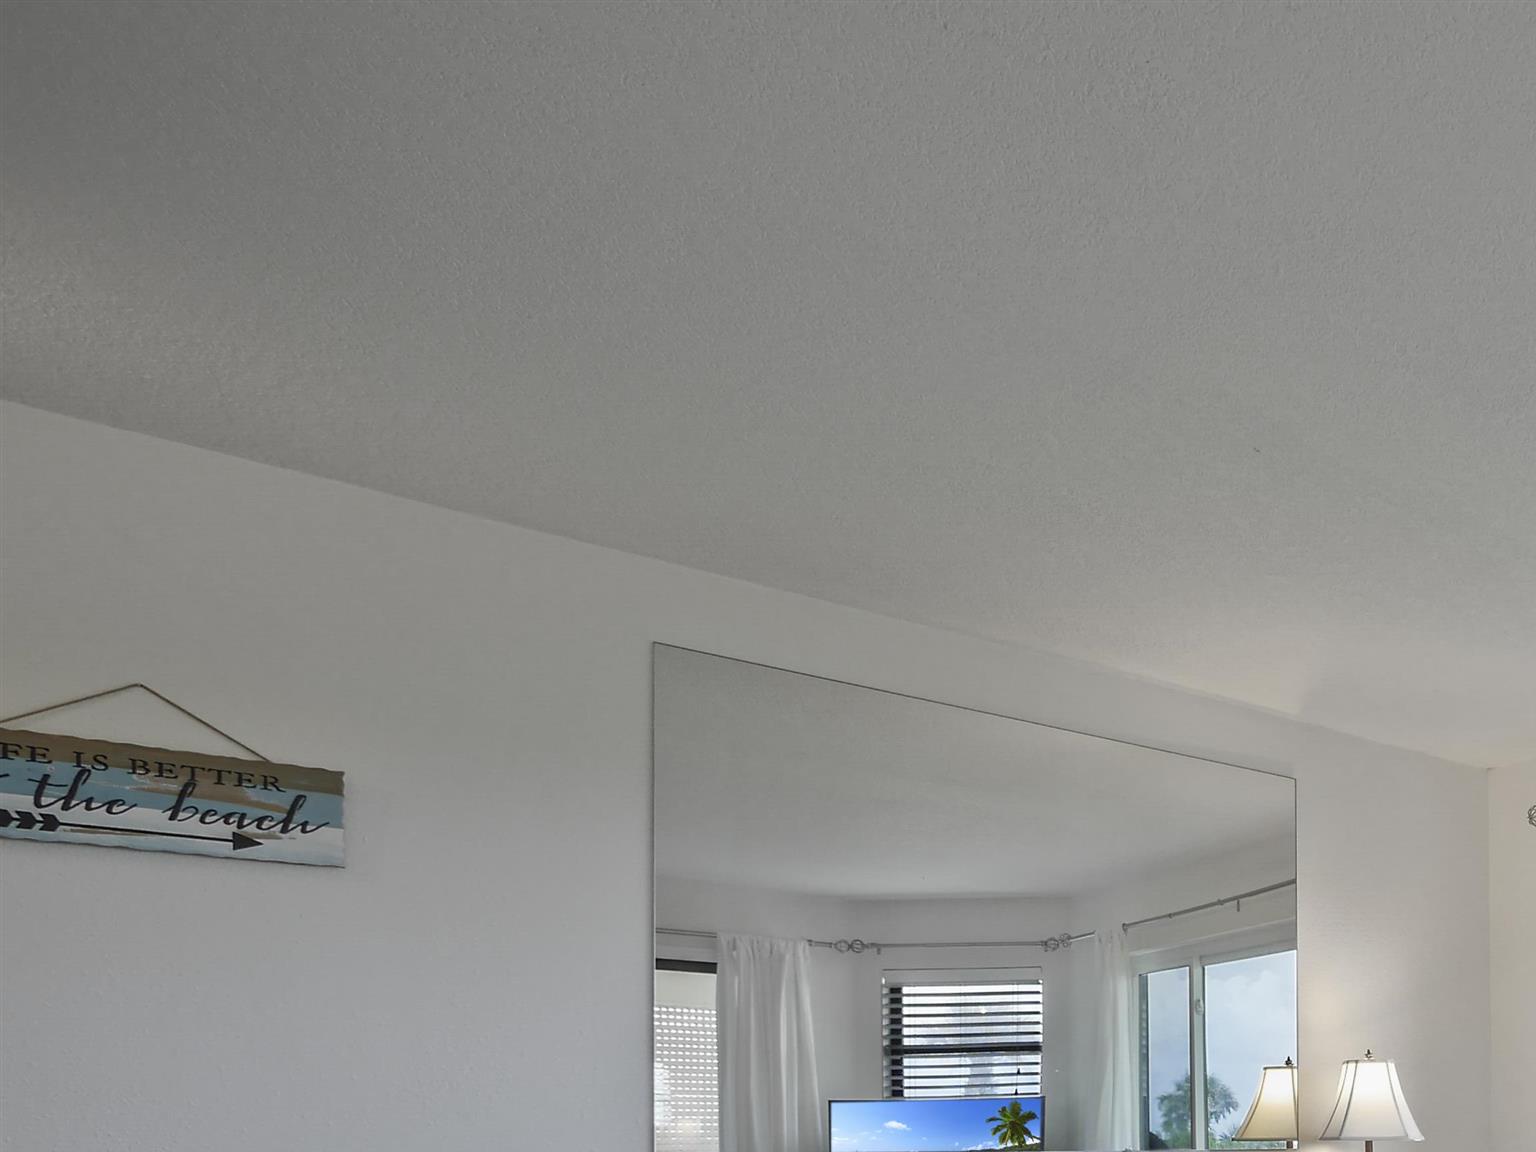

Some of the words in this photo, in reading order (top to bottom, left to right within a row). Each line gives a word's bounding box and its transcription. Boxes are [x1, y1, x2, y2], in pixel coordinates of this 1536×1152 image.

[72, 751, 109, 771] IS
[128, 758, 287, 792] BETTER
[28, 768, 137, 815] the
[161, 781, 330, 834] beach
